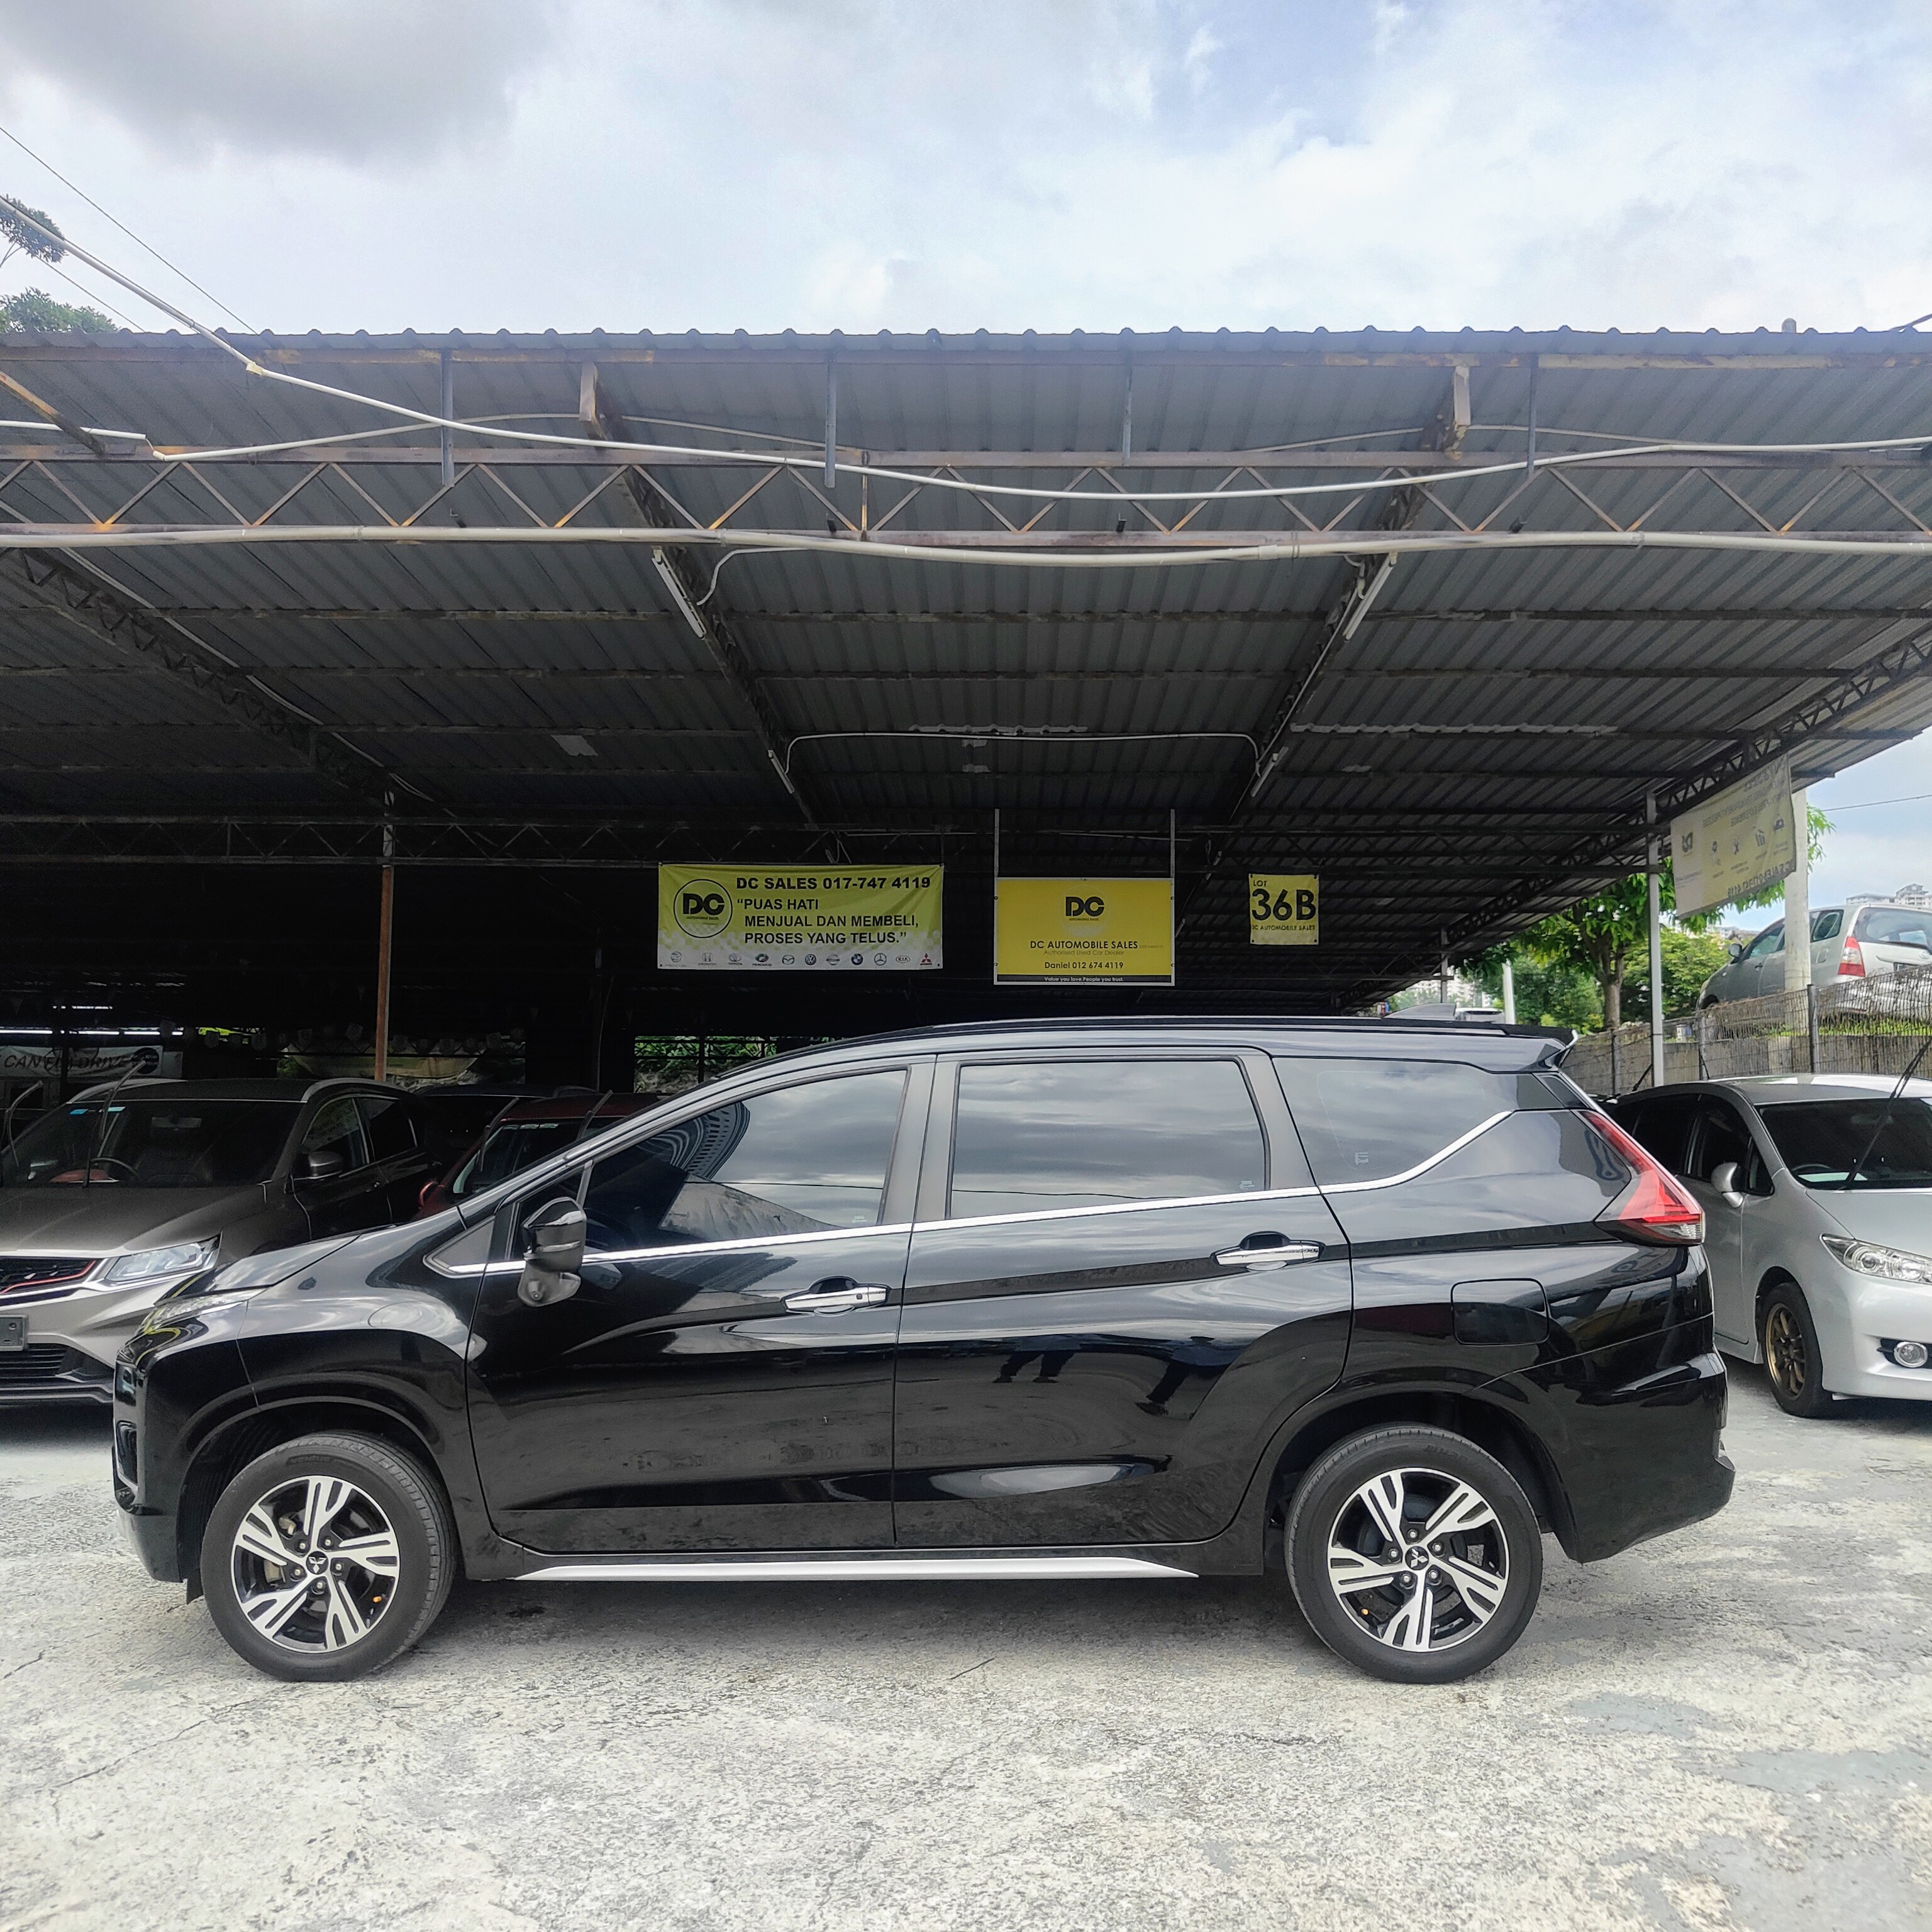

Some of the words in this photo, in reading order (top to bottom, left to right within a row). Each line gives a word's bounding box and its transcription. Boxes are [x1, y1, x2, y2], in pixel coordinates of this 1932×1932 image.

[736, 877, 758, 889] DC
[764, 877, 818, 889] SALES
[823, 877, 887, 889] 017-747
[892, 877, 930, 889] 4119
[683, 893, 725, 916] DC
[787, 899, 819, 909] HATI
[1065, 896, 1105, 917] DC
[1252, 888, 1316, 921] 36B
[745, 916, 813, 926] MENJUAL
[817, 916, 846, 926] DAN
[851, 915, 919, 928] MEMBELI,
[745, 933, 803, 944] PROSES
[807, 933, 846, 944] YANG
[1030, 941, 1045, 949] DC
[1047, 941, 1108, 949] AUTOMOBILE
[1111, 941, 1138, 949] SALES
